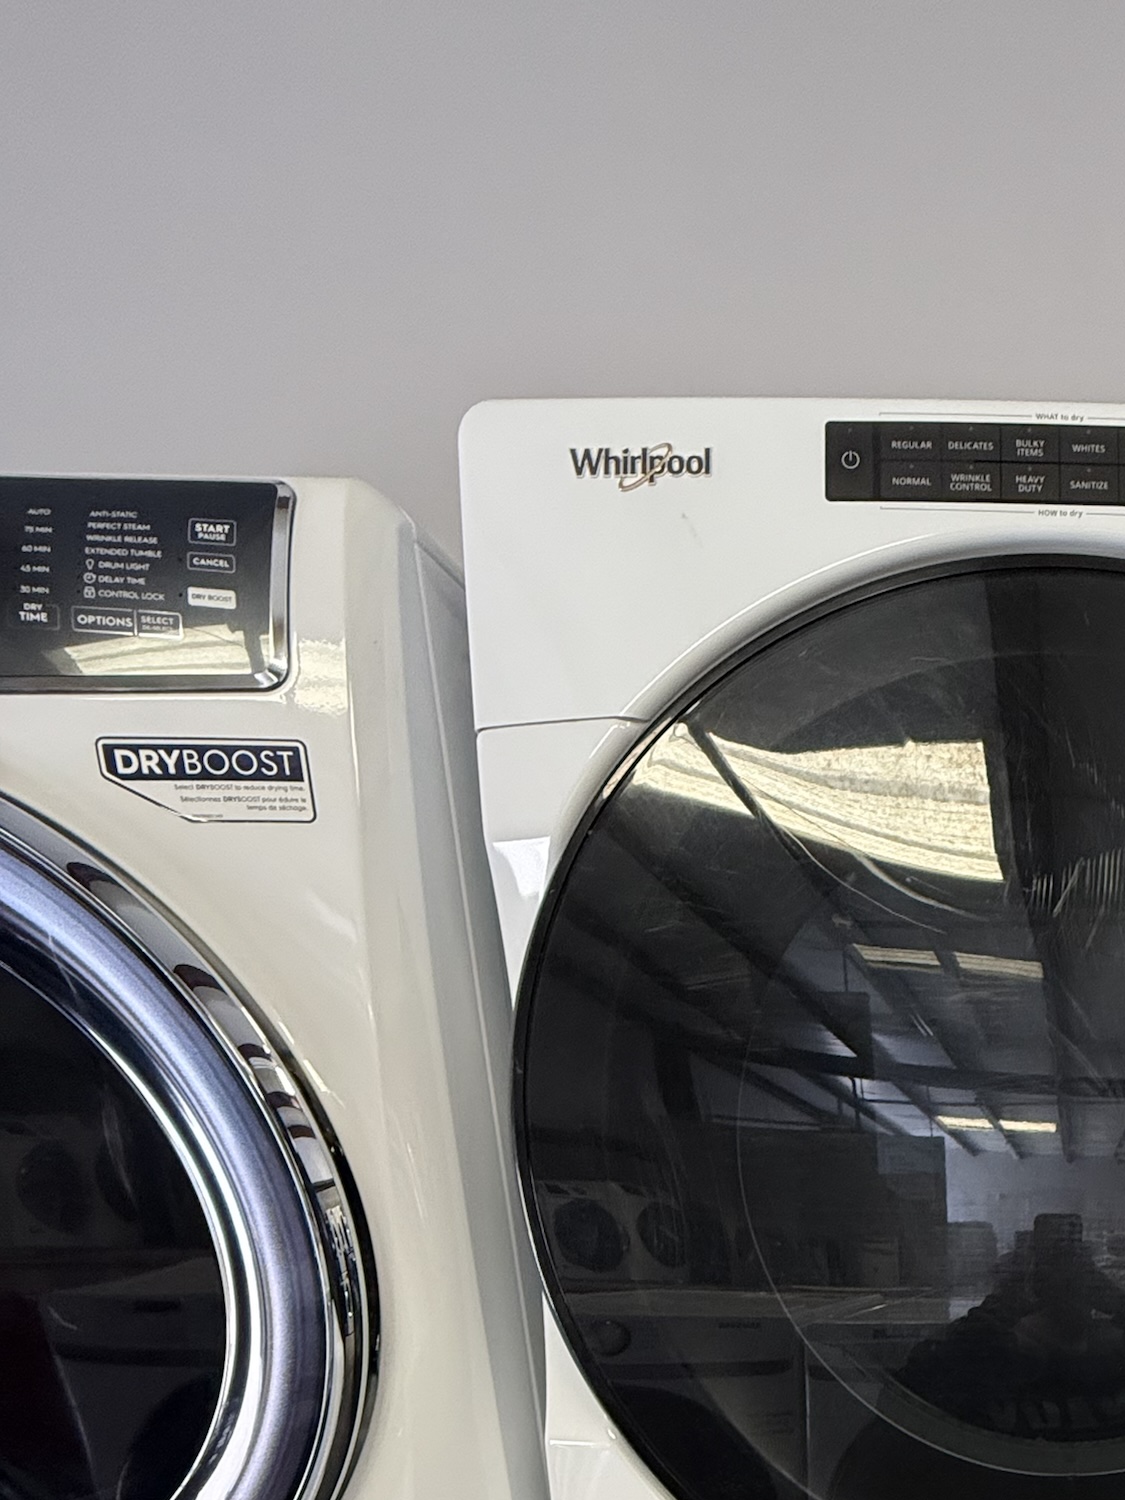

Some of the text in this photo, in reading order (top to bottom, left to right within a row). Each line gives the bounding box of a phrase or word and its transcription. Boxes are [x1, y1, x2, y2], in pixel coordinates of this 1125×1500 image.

[1071, 414, 1084, 422] dry
[891, 441, 932, 450] REGULAR
[948, 441, 994, 450] DELICATES
[1016, 439, 1045, 448] BULKY
[1017, 449, 1043, 457] ITEMS
[1072, 445, 1105, 453] WHITES
[569, 446, 712, 486] Whirlpool
[892, 477, 932, 486] NORMAL
[951, 474, 990, 483] WRINKLE
[1016, 475, 1045, 484] HEAVY
[950, 483, 992, 492] CONTROL
[1018, 484, 1043, 493] DUTY
[1070, 481, 1108, 490] SANITIZE
[1070, 510, 1083, 518] dry
[87, 522, 151, 531] PERFECT STEAM
[194, 523, 230, 534] START
[86, 534, 158, 544] WRINKLE RELEASE
[197, 532, 226, 542] PAUSE
[85, 546, 162, 558] EXTENDED TUMBLE
[98, 561, 150, 572] DRUM LIGHT
[192, 557, 230, 568] CANCEL
[98, 575, 146, 585] DELAY TIME
[32, 586, 49, 594] MIN
[98, 590, 166, 601] CONTROL LOCK
[191, 592, 206, 601] DRY
[19, 611, 48, 622] TIME
[76, 614, 133, 628] OPTIONS
[140, 616, 174, 626] SELECT
[114, 749, 293, 775] DRYBOOST
